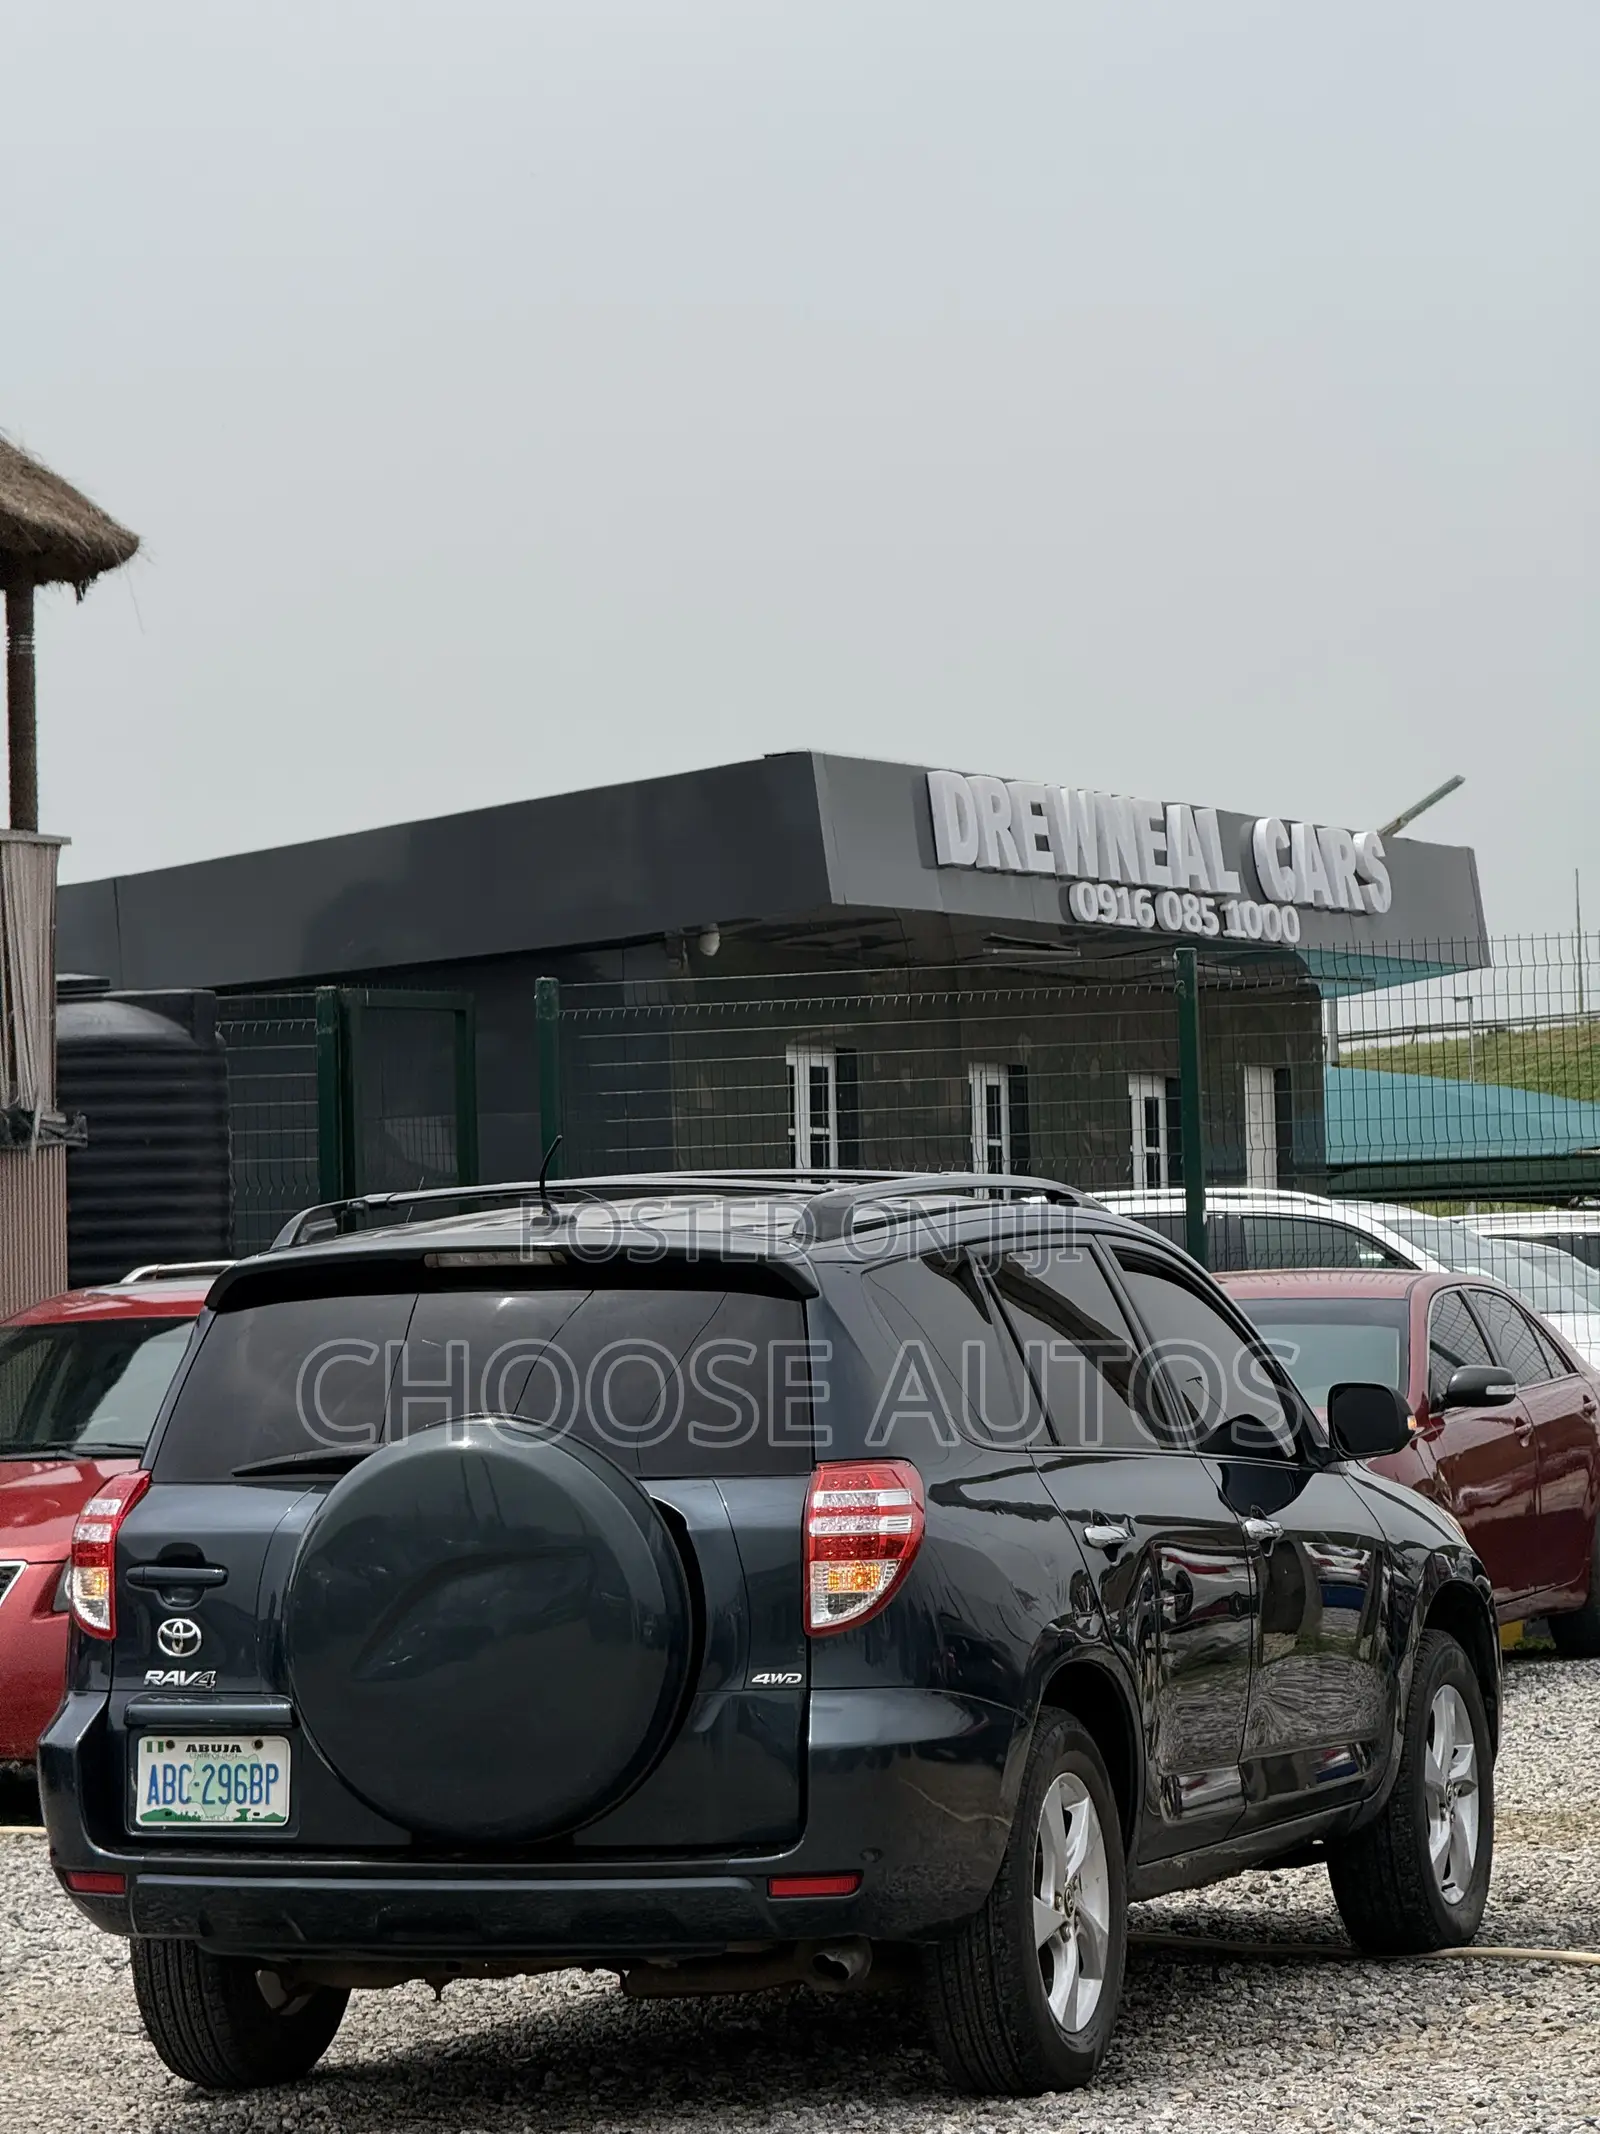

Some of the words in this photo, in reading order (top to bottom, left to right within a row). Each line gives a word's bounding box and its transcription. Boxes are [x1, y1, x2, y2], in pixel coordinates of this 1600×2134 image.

[926, 769, 1240, 894] DREWNEAL
[1252, 816, 1393, 915] CARS
[1068, 881, 1156, 929] 0916
[1154, 890, 1220, 937] 085
[1220, 899, 1301, 945] 1000
[143, 1669, 216, 1688] RAV4
[751, 1672, 803, 1684] 4WD
[185, 1743, 242, 1753] ABUJA
